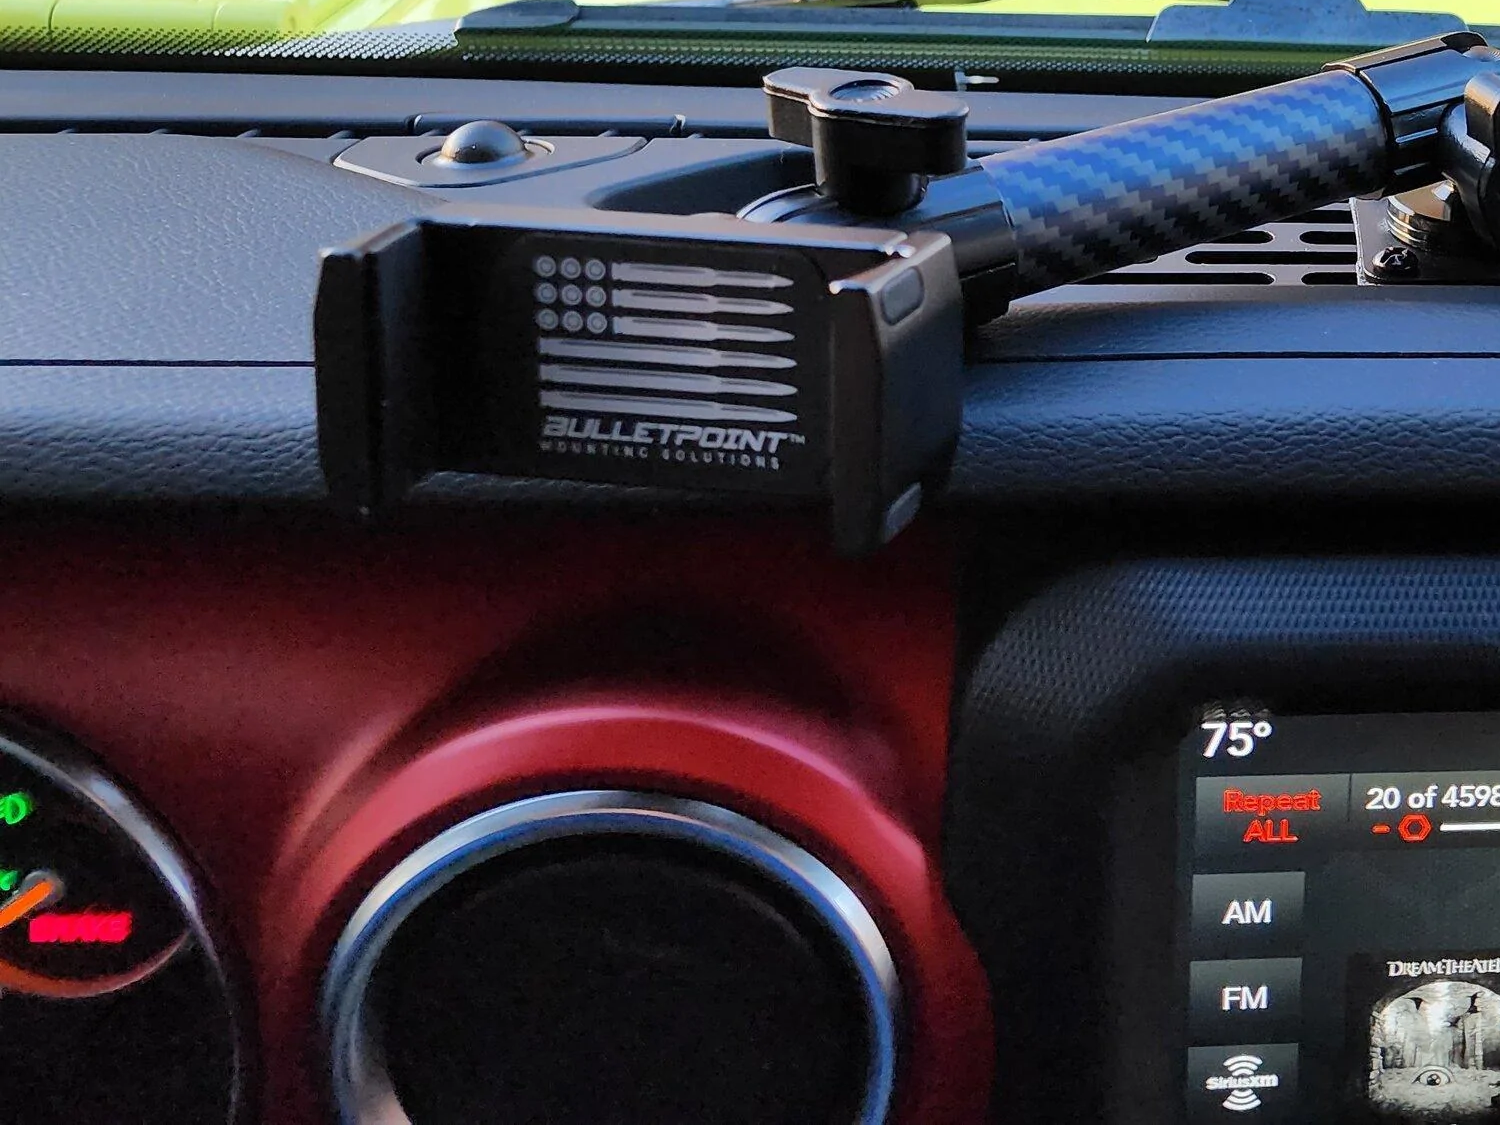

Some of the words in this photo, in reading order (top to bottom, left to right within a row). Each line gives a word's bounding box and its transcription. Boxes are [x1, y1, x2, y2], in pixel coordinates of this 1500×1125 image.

[661, 446, 780, 470] SOLUTIONS
[1223, 788, 1321, 815] Repeat
[1365, 788, 1400, 810] 20
[1408, 787, 1437, 808] of
[1243, 819, 1299, 843] ALL
[1222, 899, 1272, 925] AM
[1222, 985, 1268, 1010] FM
